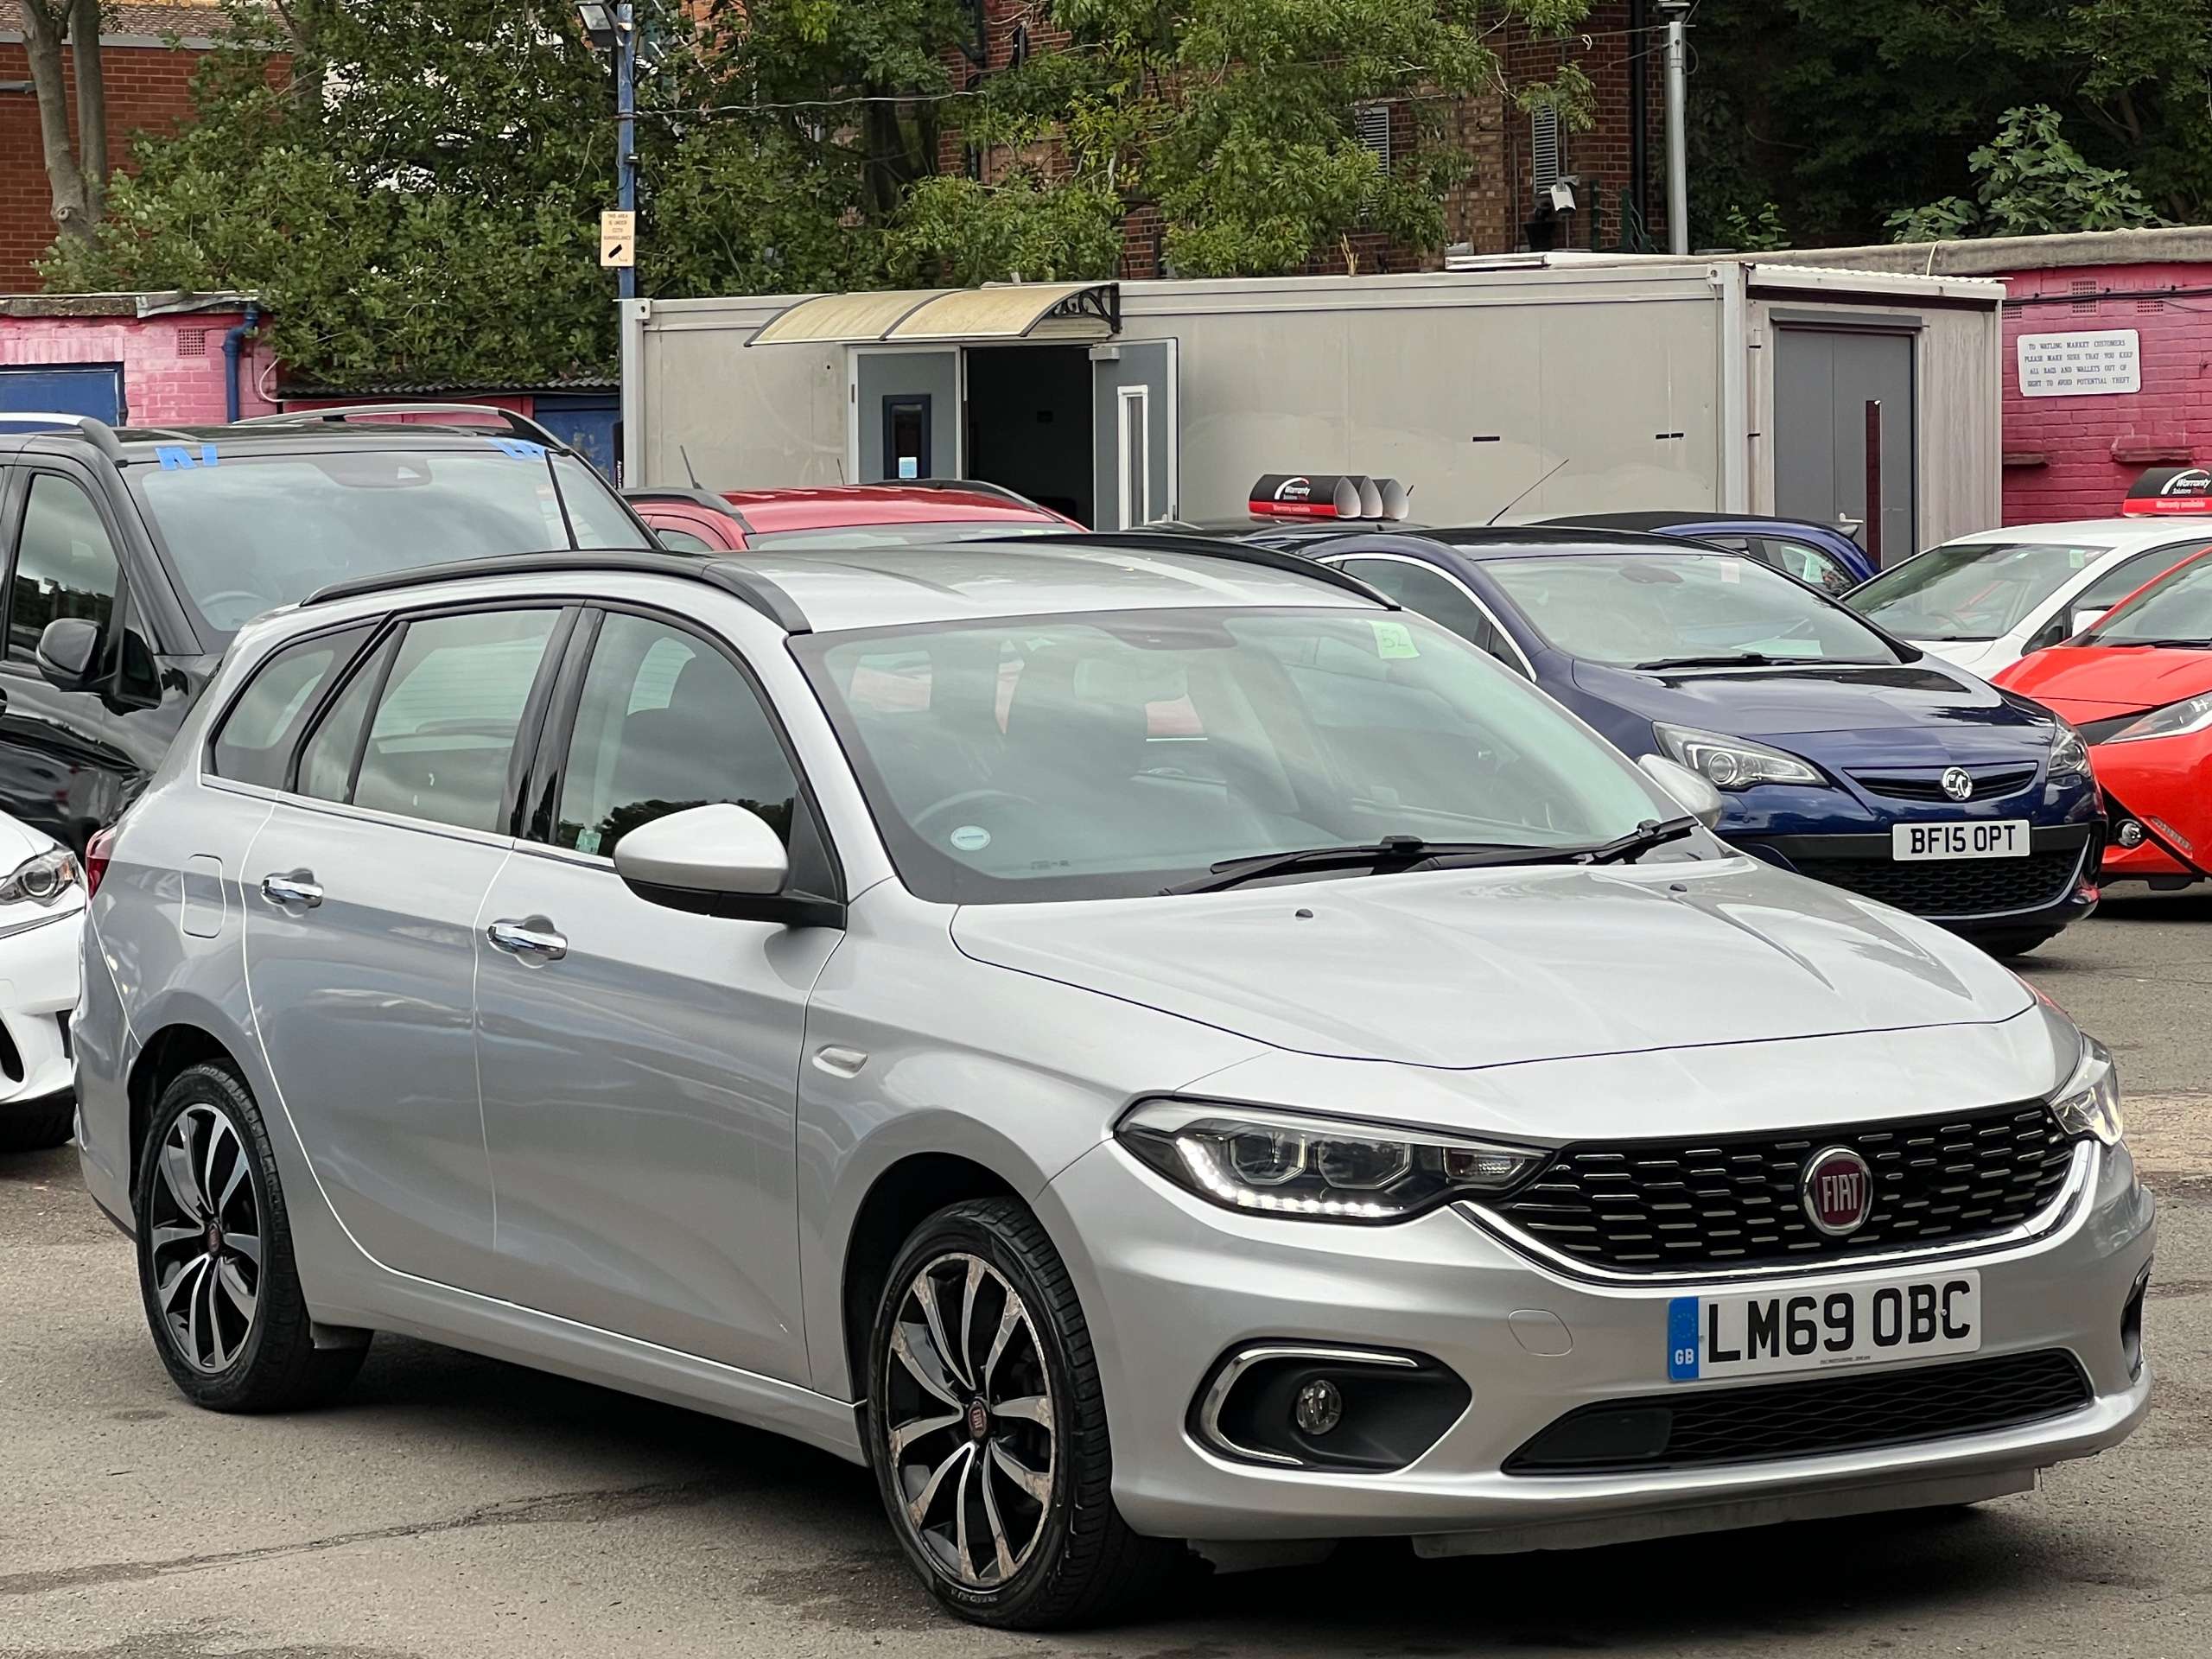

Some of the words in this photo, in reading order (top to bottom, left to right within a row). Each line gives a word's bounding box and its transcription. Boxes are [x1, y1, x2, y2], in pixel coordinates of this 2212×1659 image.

[2076, 377, 2107, 385] POTENTIAL
[2176, 478, 2212, 489] Warranty
[1910, 827, 1966, 854] BF15
[1974, 825, 2016, 851] OPT
[1821, 1173, 1859, 1213] FIAT
[1708, 1292, 1854, 1363] LM69
[1872, 1280, 1971, 1348] OBC
[1675, 1348, 1694, 1366] GB
